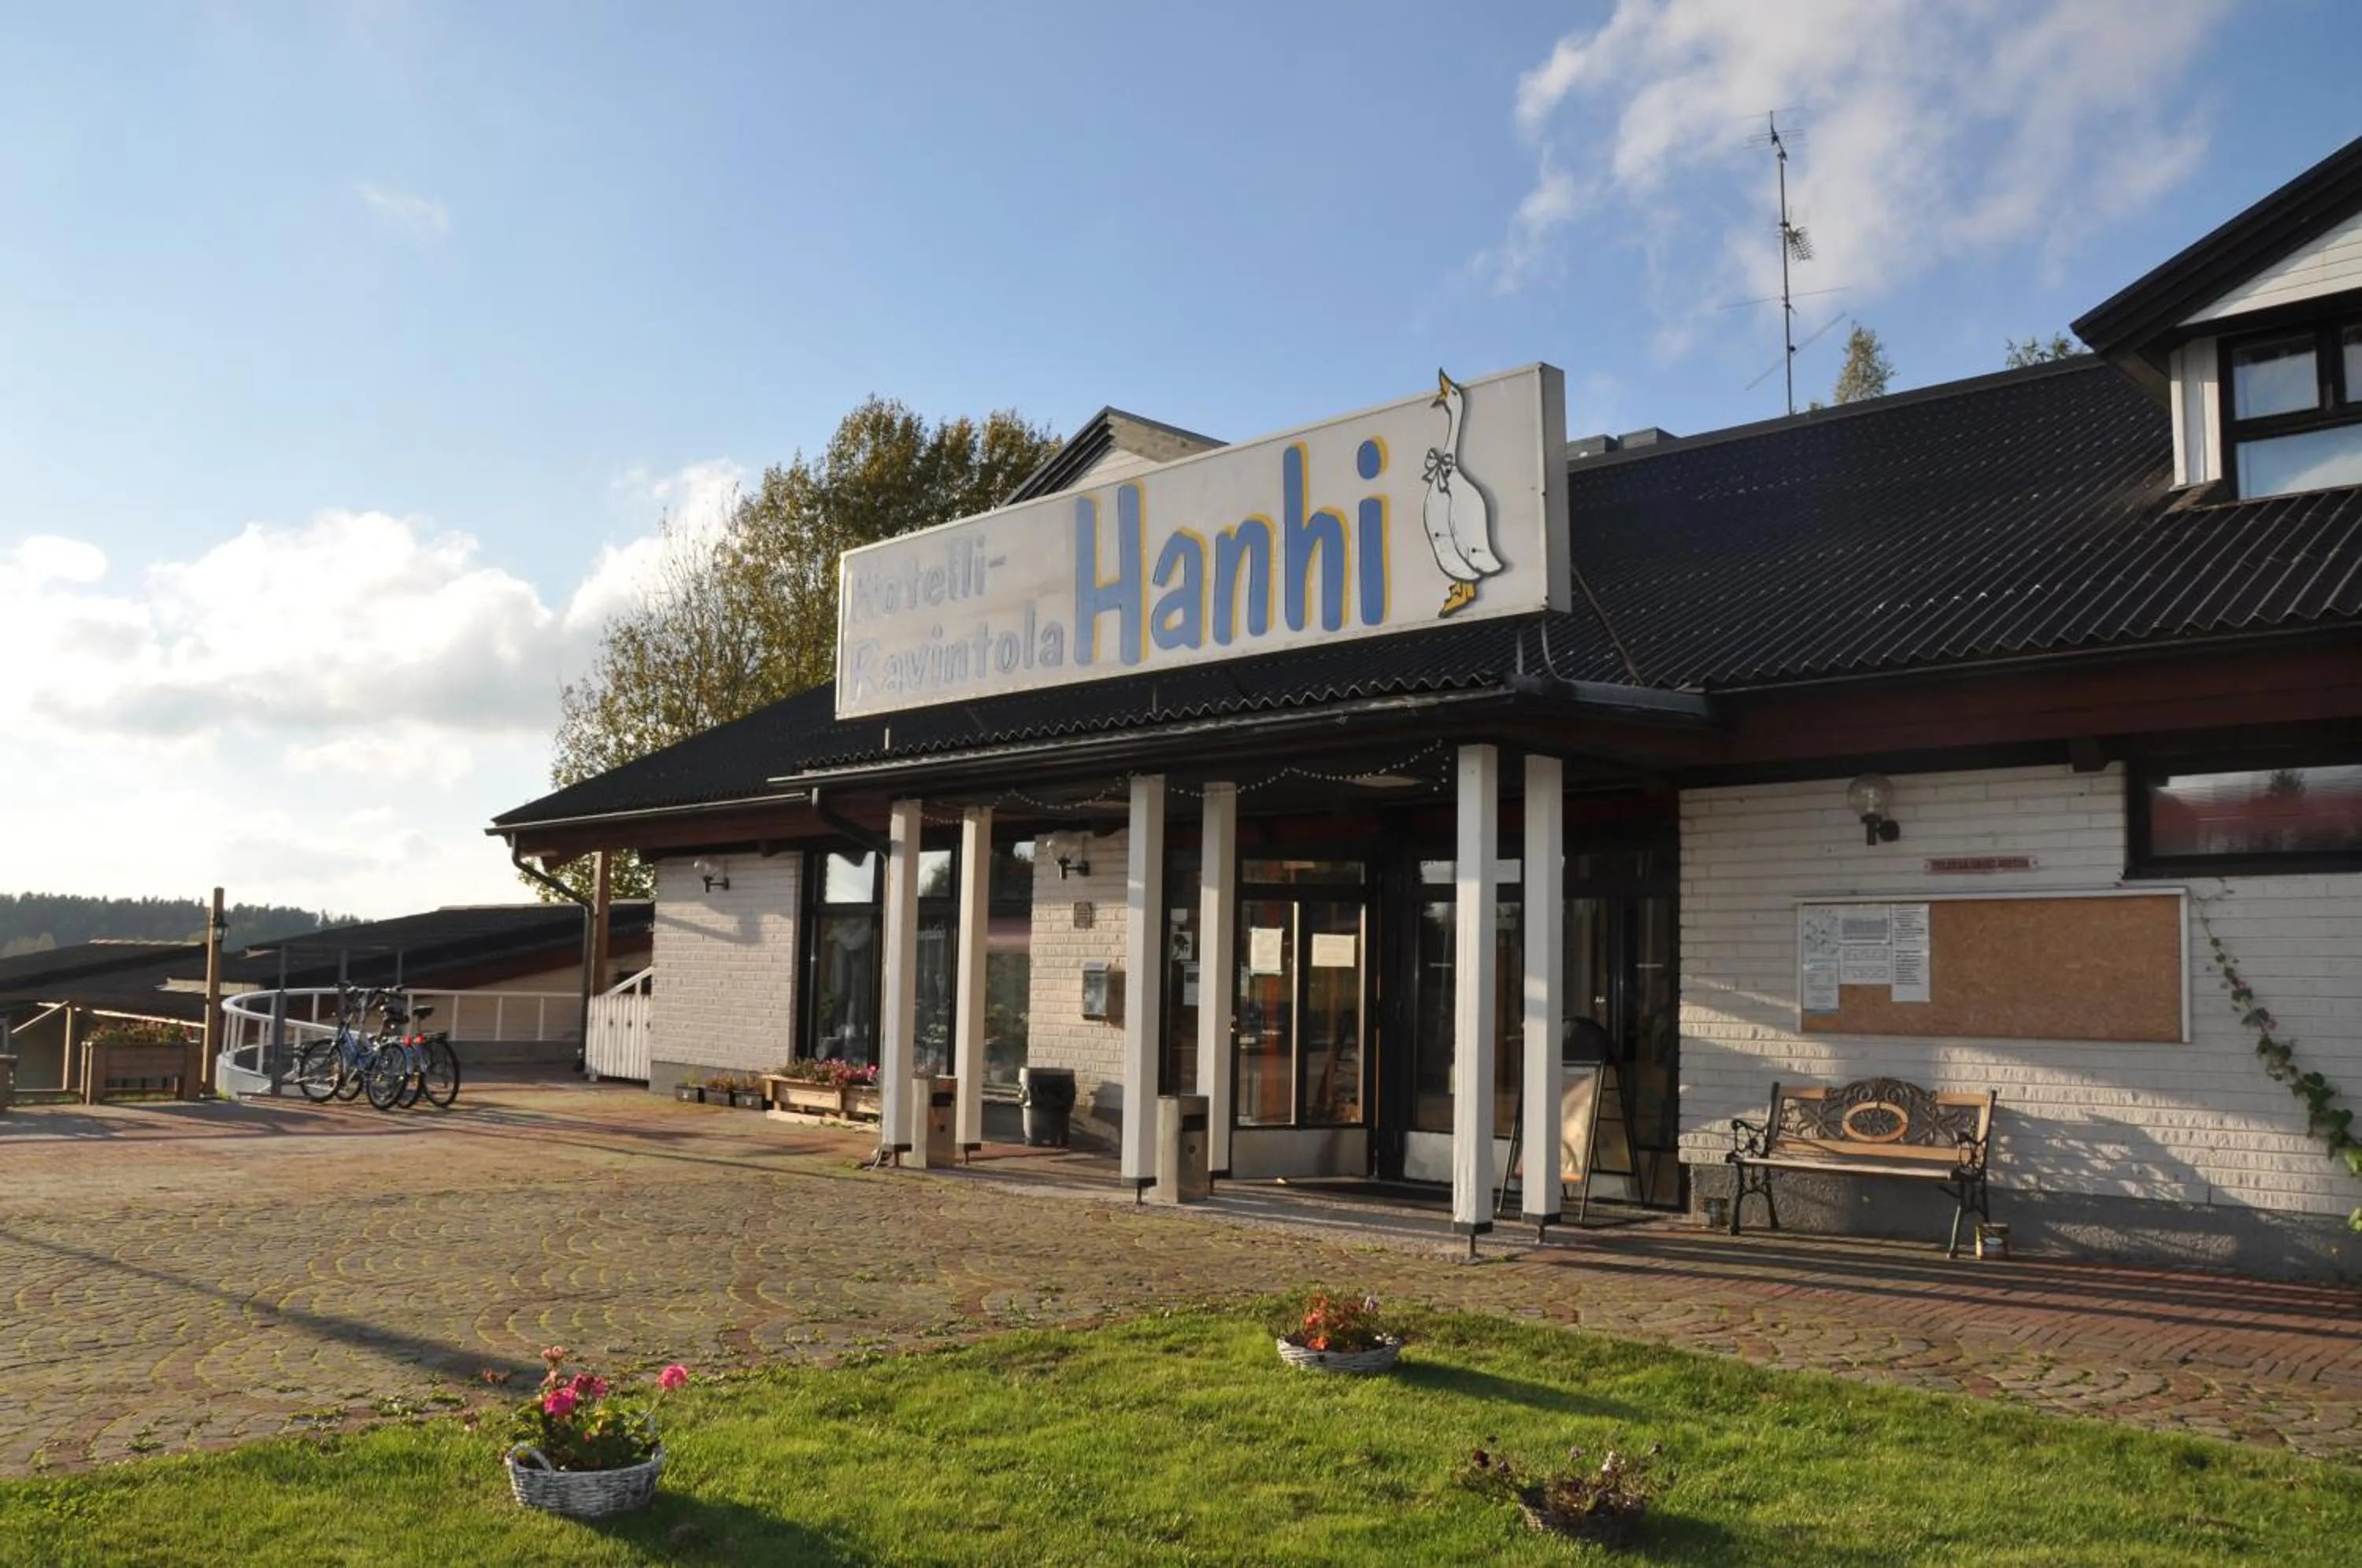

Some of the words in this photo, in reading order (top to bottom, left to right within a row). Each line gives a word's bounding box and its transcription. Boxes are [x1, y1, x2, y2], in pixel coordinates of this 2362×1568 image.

[850, 534, 1007, 624] Hotelli-
[1074, 435, 1392, 667] Hanhi
[849, 600, 1064, 703] Ravintola
